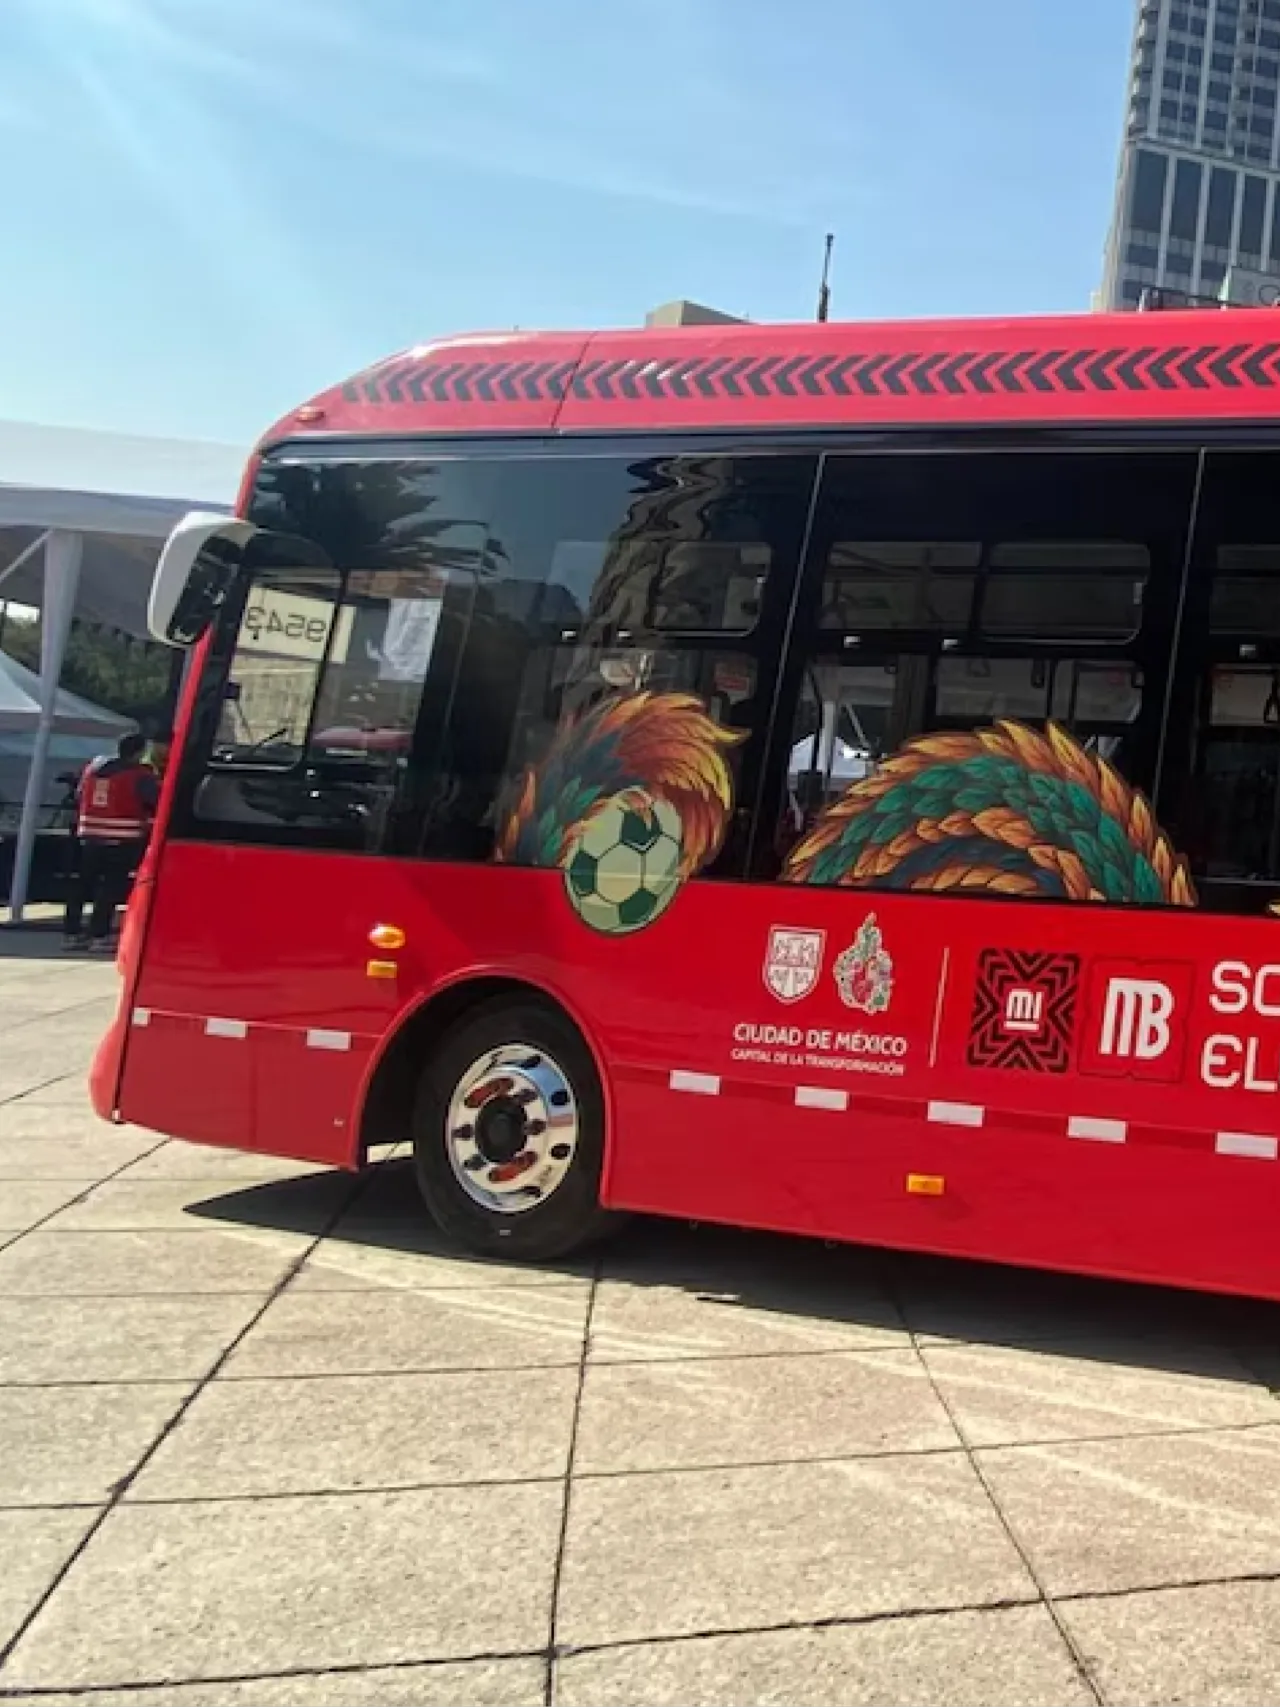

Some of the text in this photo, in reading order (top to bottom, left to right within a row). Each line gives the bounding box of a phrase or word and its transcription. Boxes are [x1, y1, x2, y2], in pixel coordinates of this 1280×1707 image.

[1099, 977, 1175, 1060] MB
[731, 1048, 771, 1063] CAPITAL
[773, 1051, 788, 1065] DE
[789, 1053, 803, 1066] LA
[733, 1023, 908, 1057] CIUDAD DE MÉXICO
